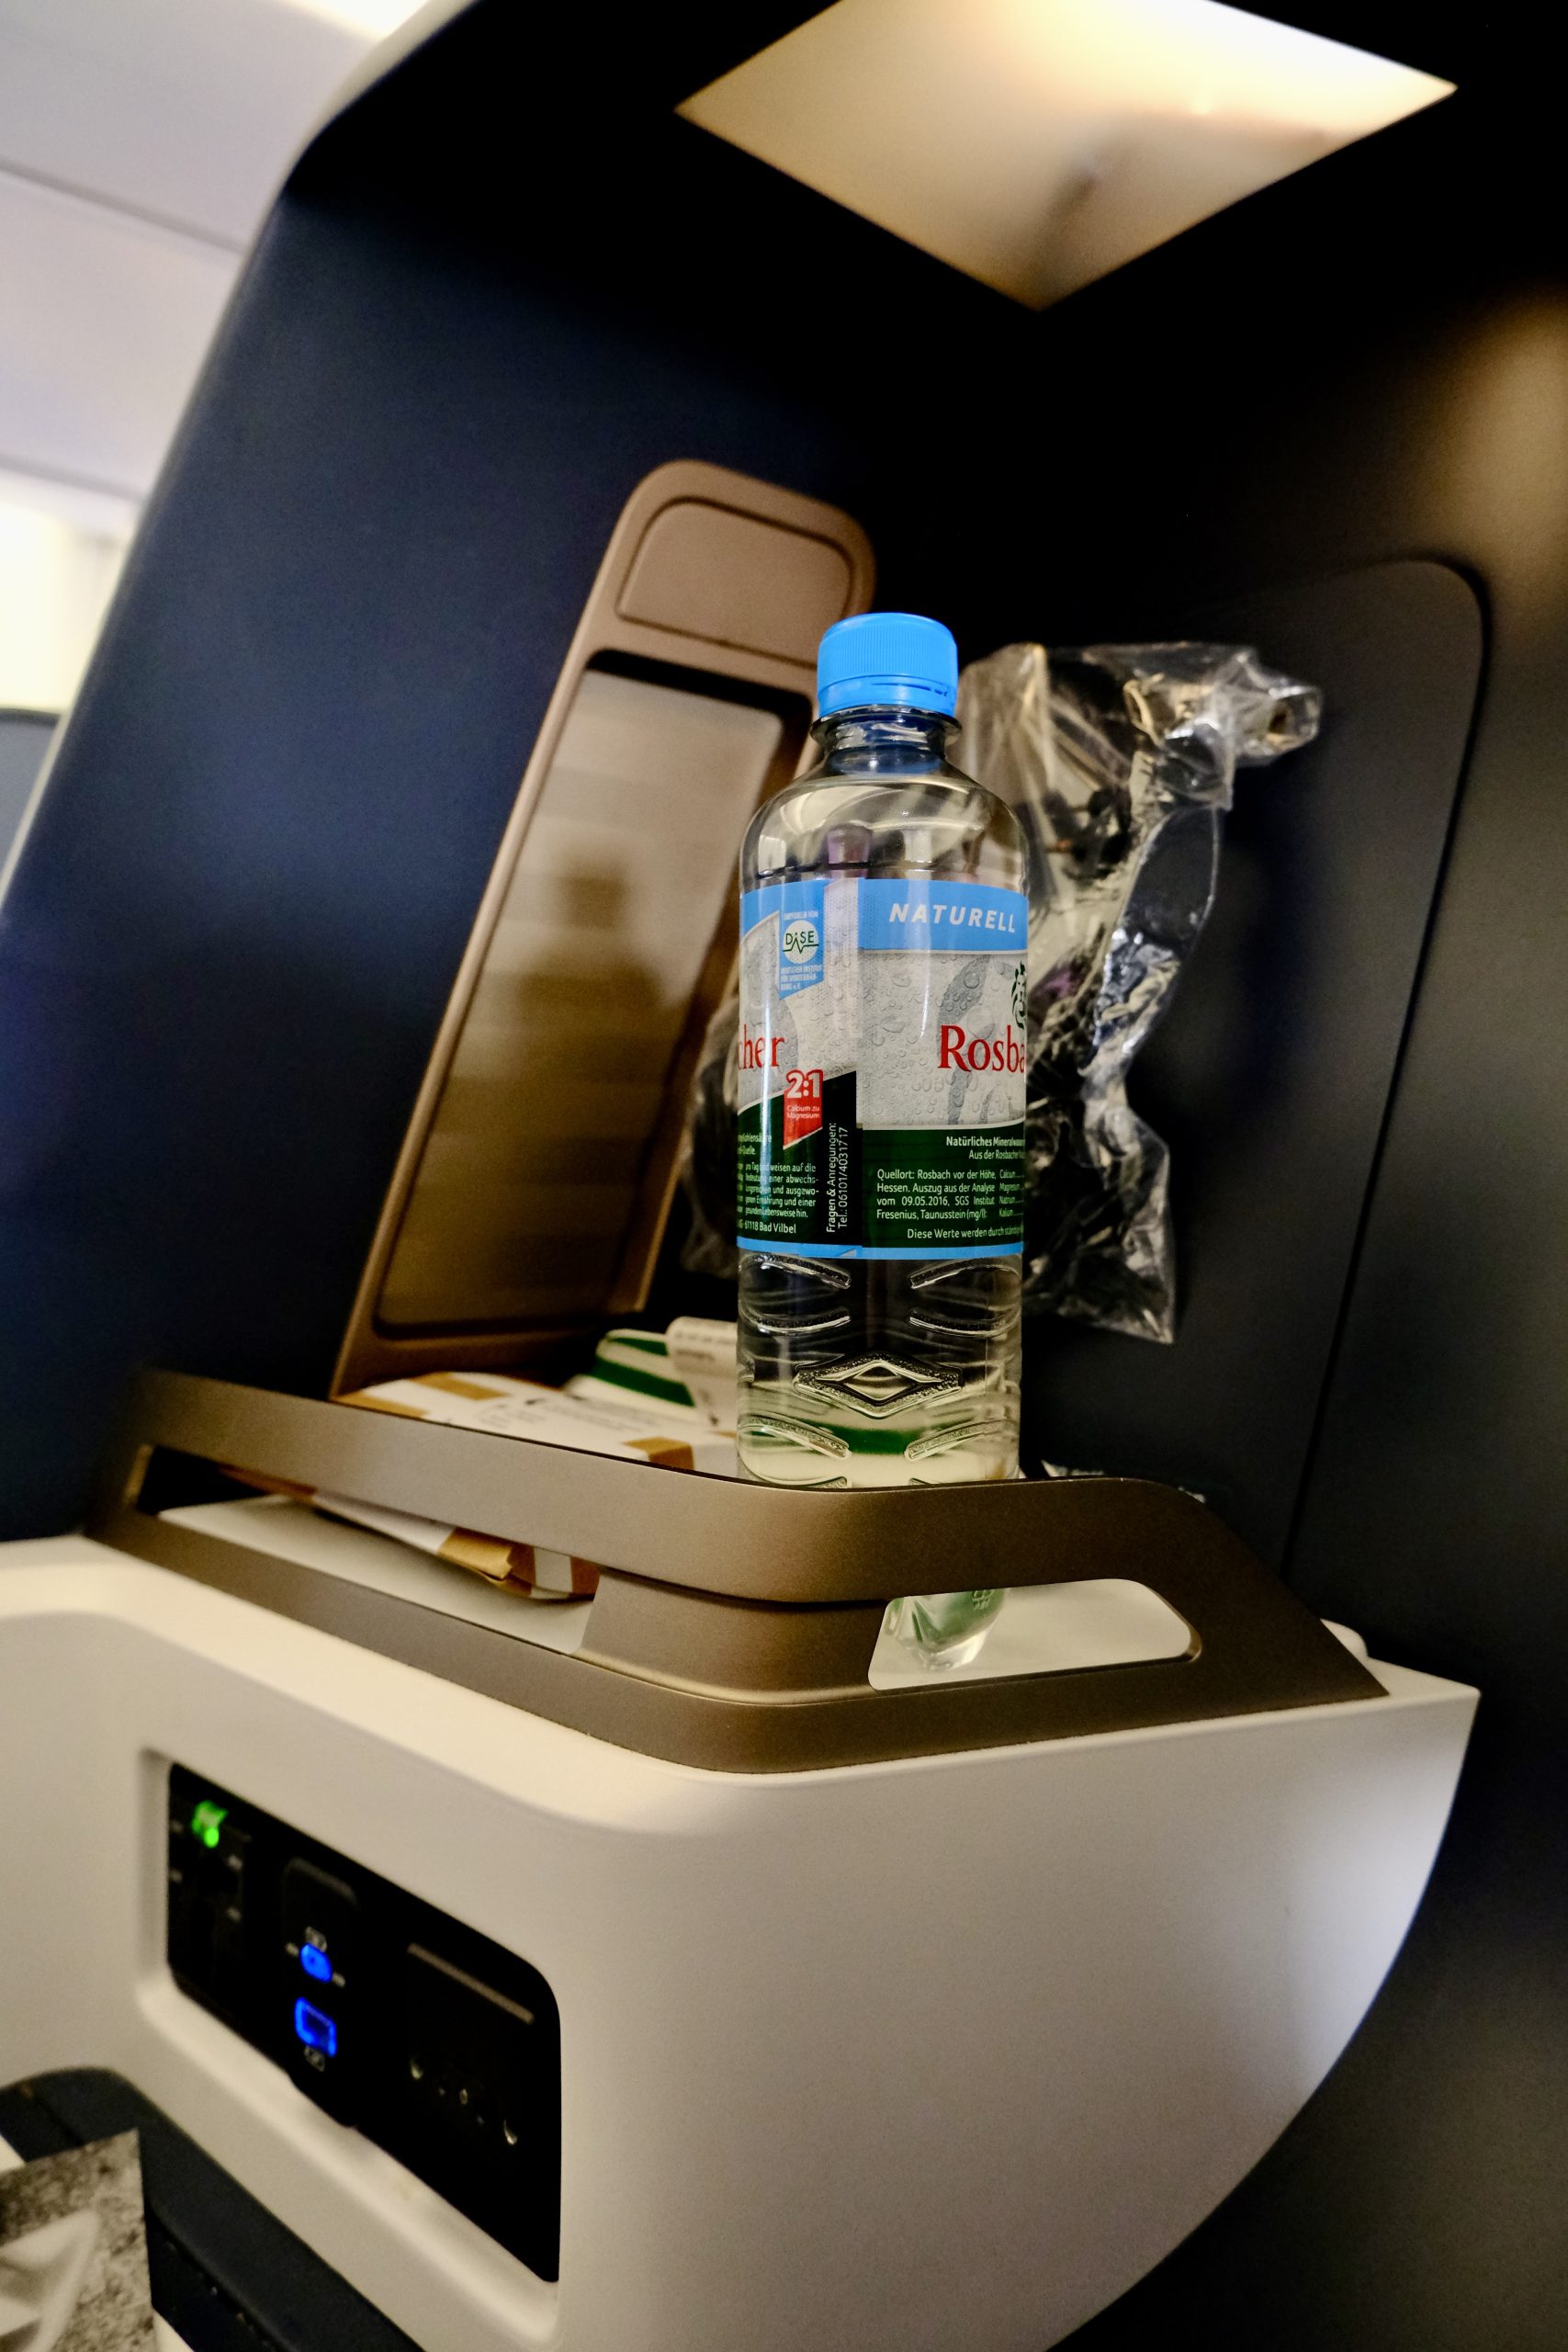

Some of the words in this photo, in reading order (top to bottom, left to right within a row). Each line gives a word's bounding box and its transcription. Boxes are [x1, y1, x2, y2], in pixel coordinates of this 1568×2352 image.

[888, 903, 1016, 933] NATURELL
[786, 1069, 823, 1099] 2:1
[946, 1136, 992, 1147] Natürliches
[826, 1122, 840, 1187] Anregungen:
[969, 1149, 983, 1159] Aus
[984, 1149, 995, 1159] der
[770, 1162, 791, 1172] weisen
[791, 1162, 804, 1172] auf
[804, 1163, 817, 1172] die
[785, 1175, 819, 1183] abwechs-
[877, 1169, 915, 1182] Quellort:
[917, 1169, 951, 1180] Rosbach
[953, 1171, 964, 1180] vor
[967, 1170, 978, 1180] der
[979, 1169, 997, 1181] Höhe,
[773, 1185, 784, 1194] und
[785, 1187, 819, 1197] ausgewo-
[826, 1188, 837, 1198] &
[877, 1182, 911, 1193] Hessen.
[912, 1182, 942, 1195] Auszug
[943, 1185, 957, 1193] aus
[958, 1182, 970, 1193] der
[972, 1182, 995, 1195] Analyse
[784, 1196, 797, 1206] und
[797, 1198, 817, 1207] einer
[876, 1198, 896, 1206] vom
[901, 1195, 950, 1207] 09.05.2016,
[954, 1195, 970, 1206] SGS
[974, 1196, 995, 1205] Institut
[795, 1208, 808, 1218] hin.
[826, 1199, 839, 1233] Fragen
[876, 1208, 919, 1221] Fresenius,
[920, 1208, 966, 1220] Taunusstein
[759, 1221, 773, 1232] Bad
[773, 1223, 797, 1234] Vilbel
[907, 1227, 933, 1239] Diese
[933, 1227, 960, 1238] Werte
[961, 1227, 987, 1238] werden
[987, 1227, 1005, 1237] durch
